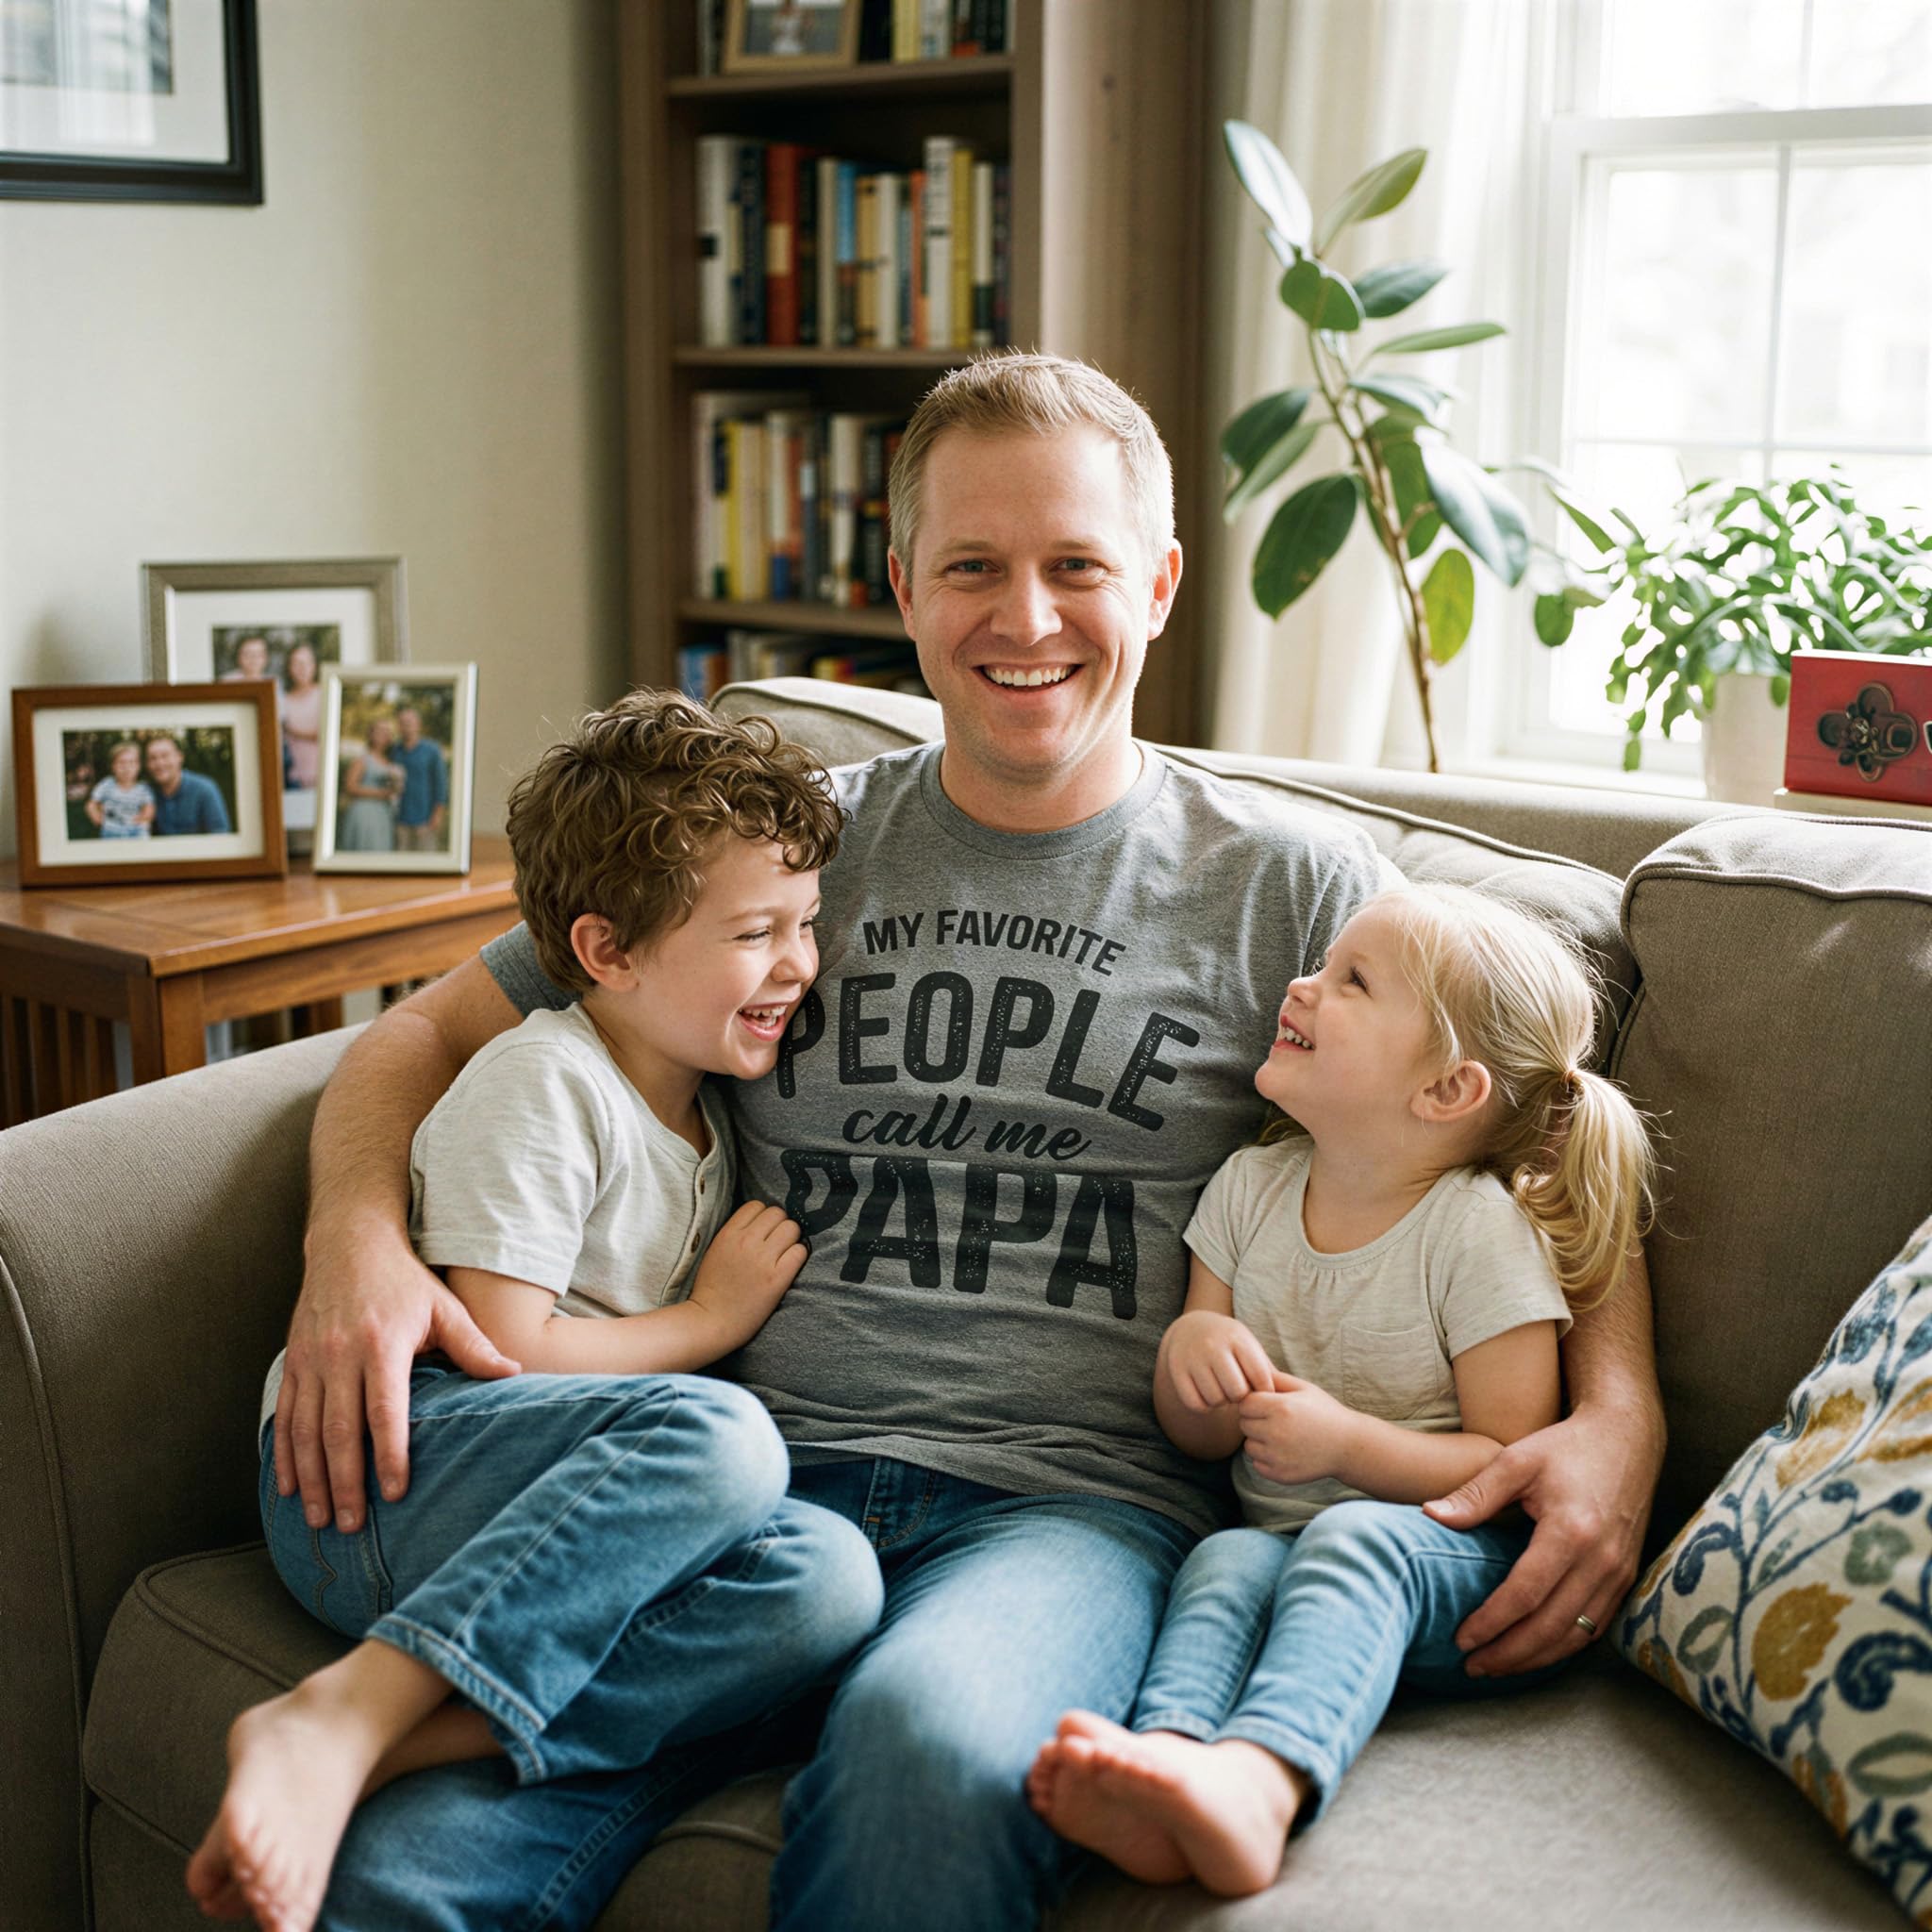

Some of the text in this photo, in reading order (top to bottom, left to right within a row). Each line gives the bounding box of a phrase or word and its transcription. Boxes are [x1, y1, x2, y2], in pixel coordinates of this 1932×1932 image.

[862, 908, 1126, 976] MY FAVORITE
[776, 971, 1201, 1132] PEOPLE
[841, 1092, 1092, 1161] call me
[780, 1148, 1138, 1321] PAPA
